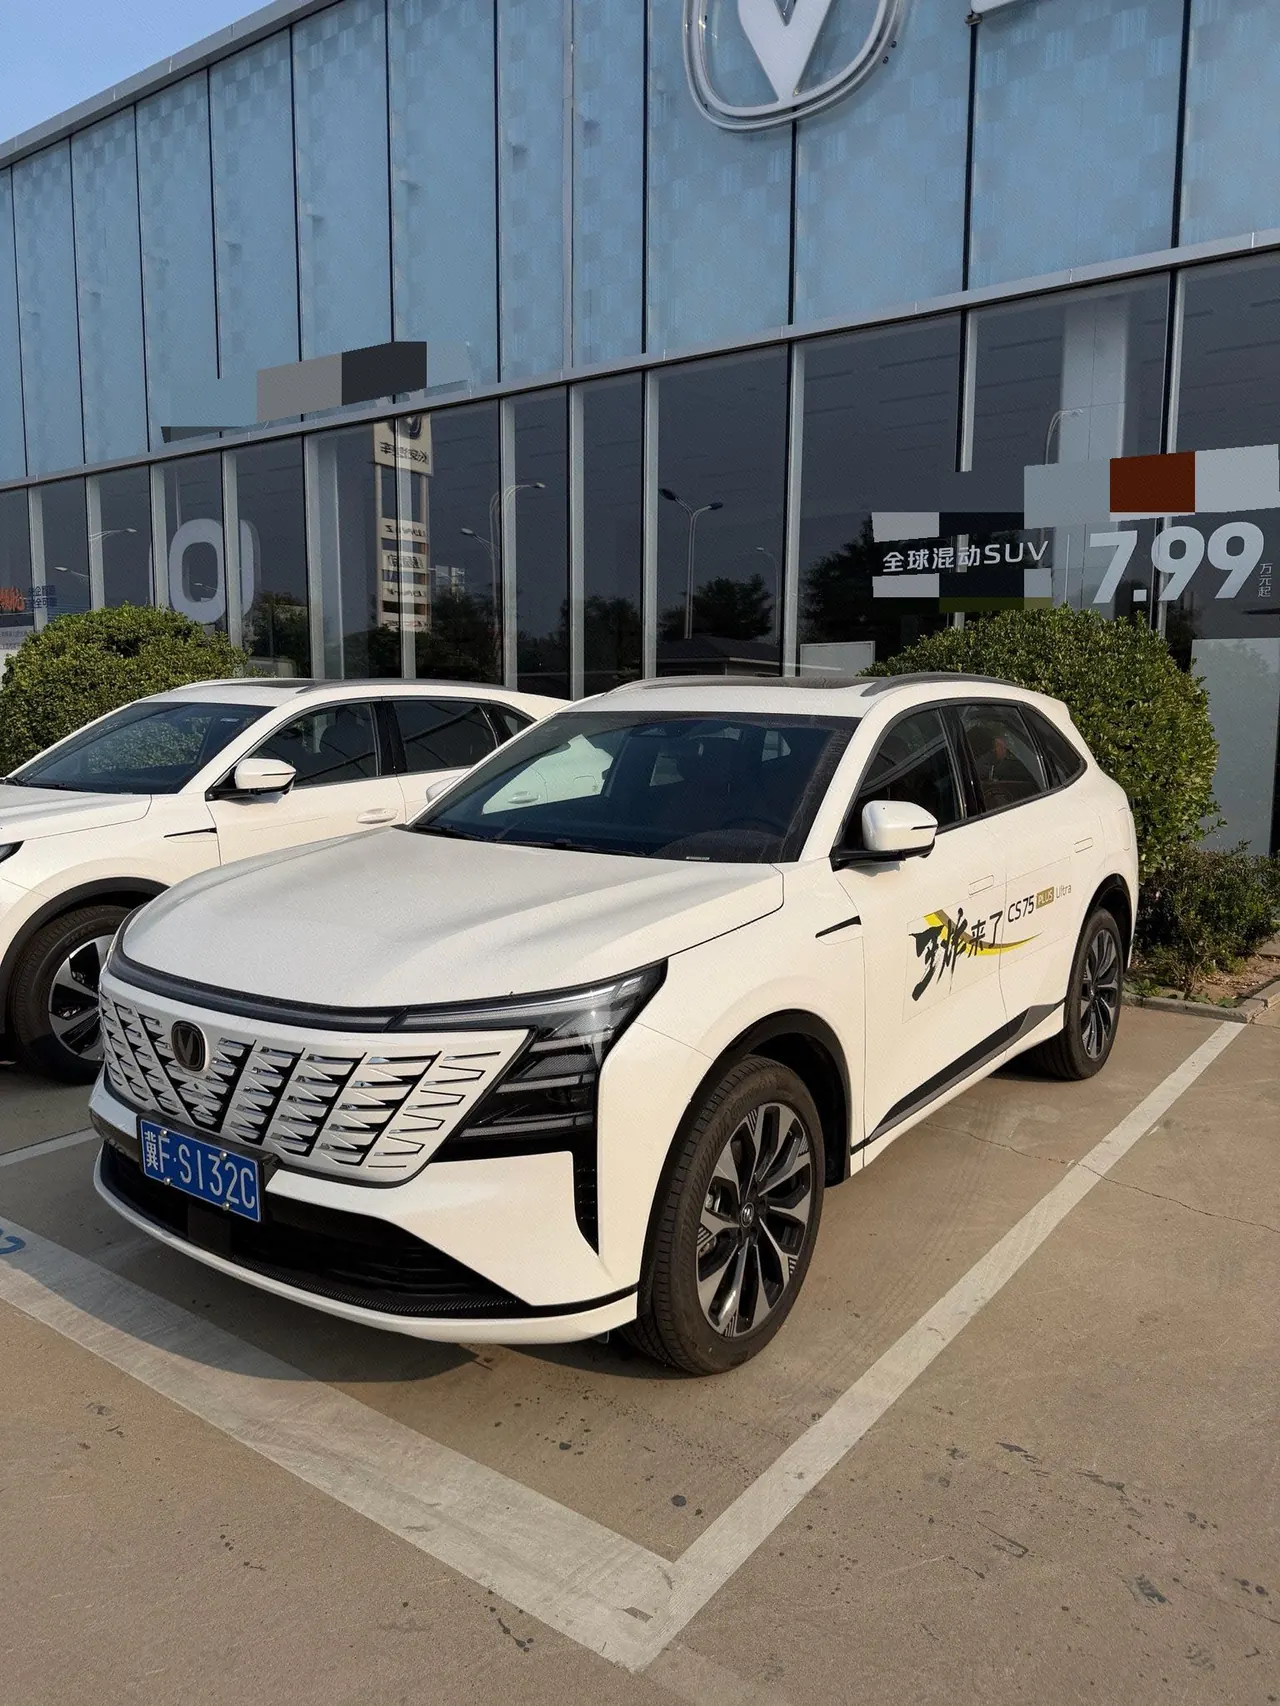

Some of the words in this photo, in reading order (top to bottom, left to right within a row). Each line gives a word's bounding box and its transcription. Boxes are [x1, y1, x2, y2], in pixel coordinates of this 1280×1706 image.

[882, 540, 1049, 573] 全球混动SUV
[1089, 521, 1264, 604] 7.99
[1258, 562, 1274, 598] 万元起
[1007, 895, 1035, 923] CS75
[1037, 888, 1054, 906] PLUS
[1056, 883, 1072, 899] Ultra
